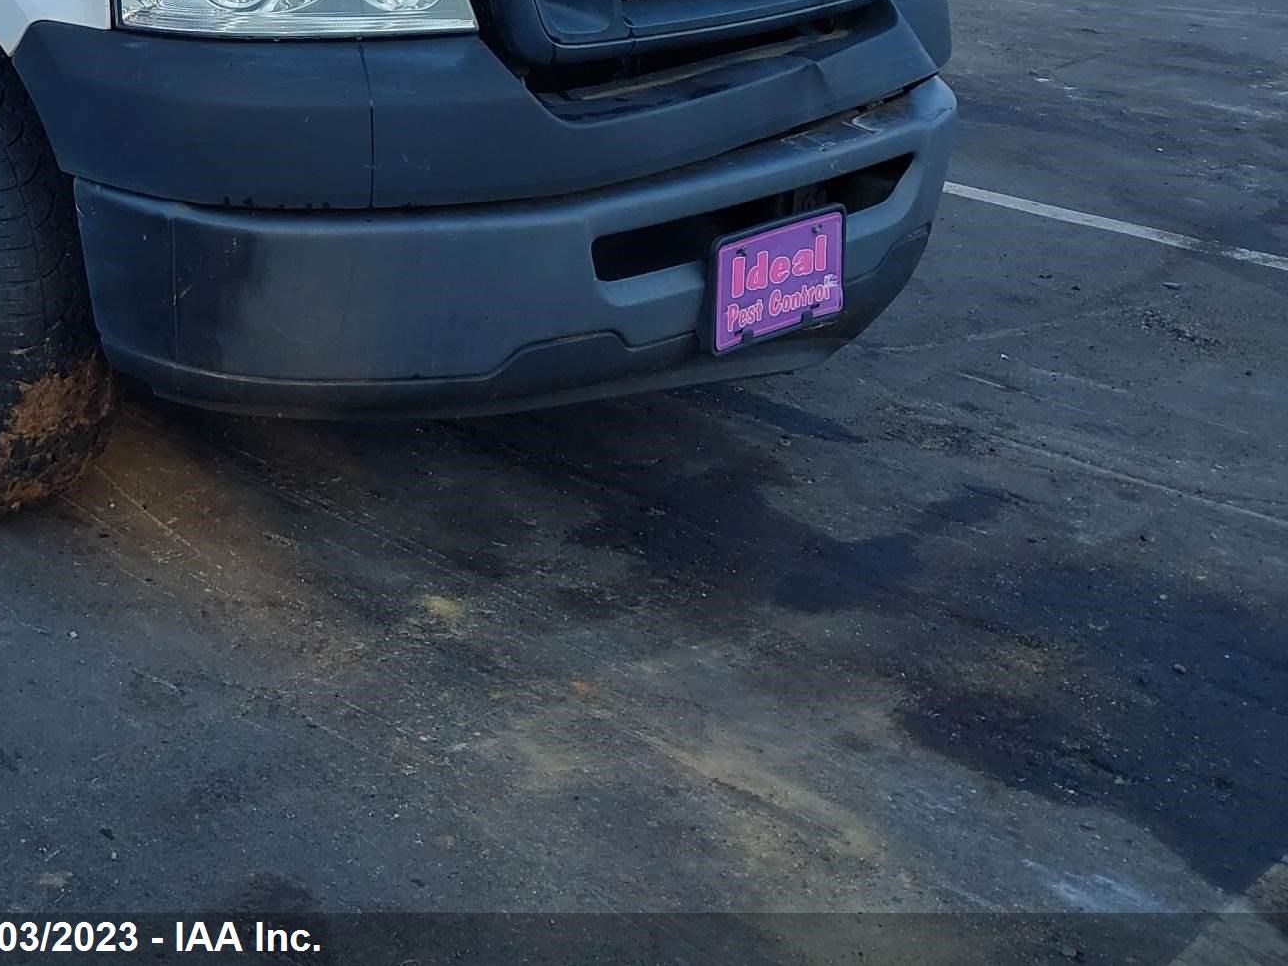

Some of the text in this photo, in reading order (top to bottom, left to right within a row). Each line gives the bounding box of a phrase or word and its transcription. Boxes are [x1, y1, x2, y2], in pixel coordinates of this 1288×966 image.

[731, 234, 828, 299] Ideal
[727, 283, 832, 332] Pest Control
